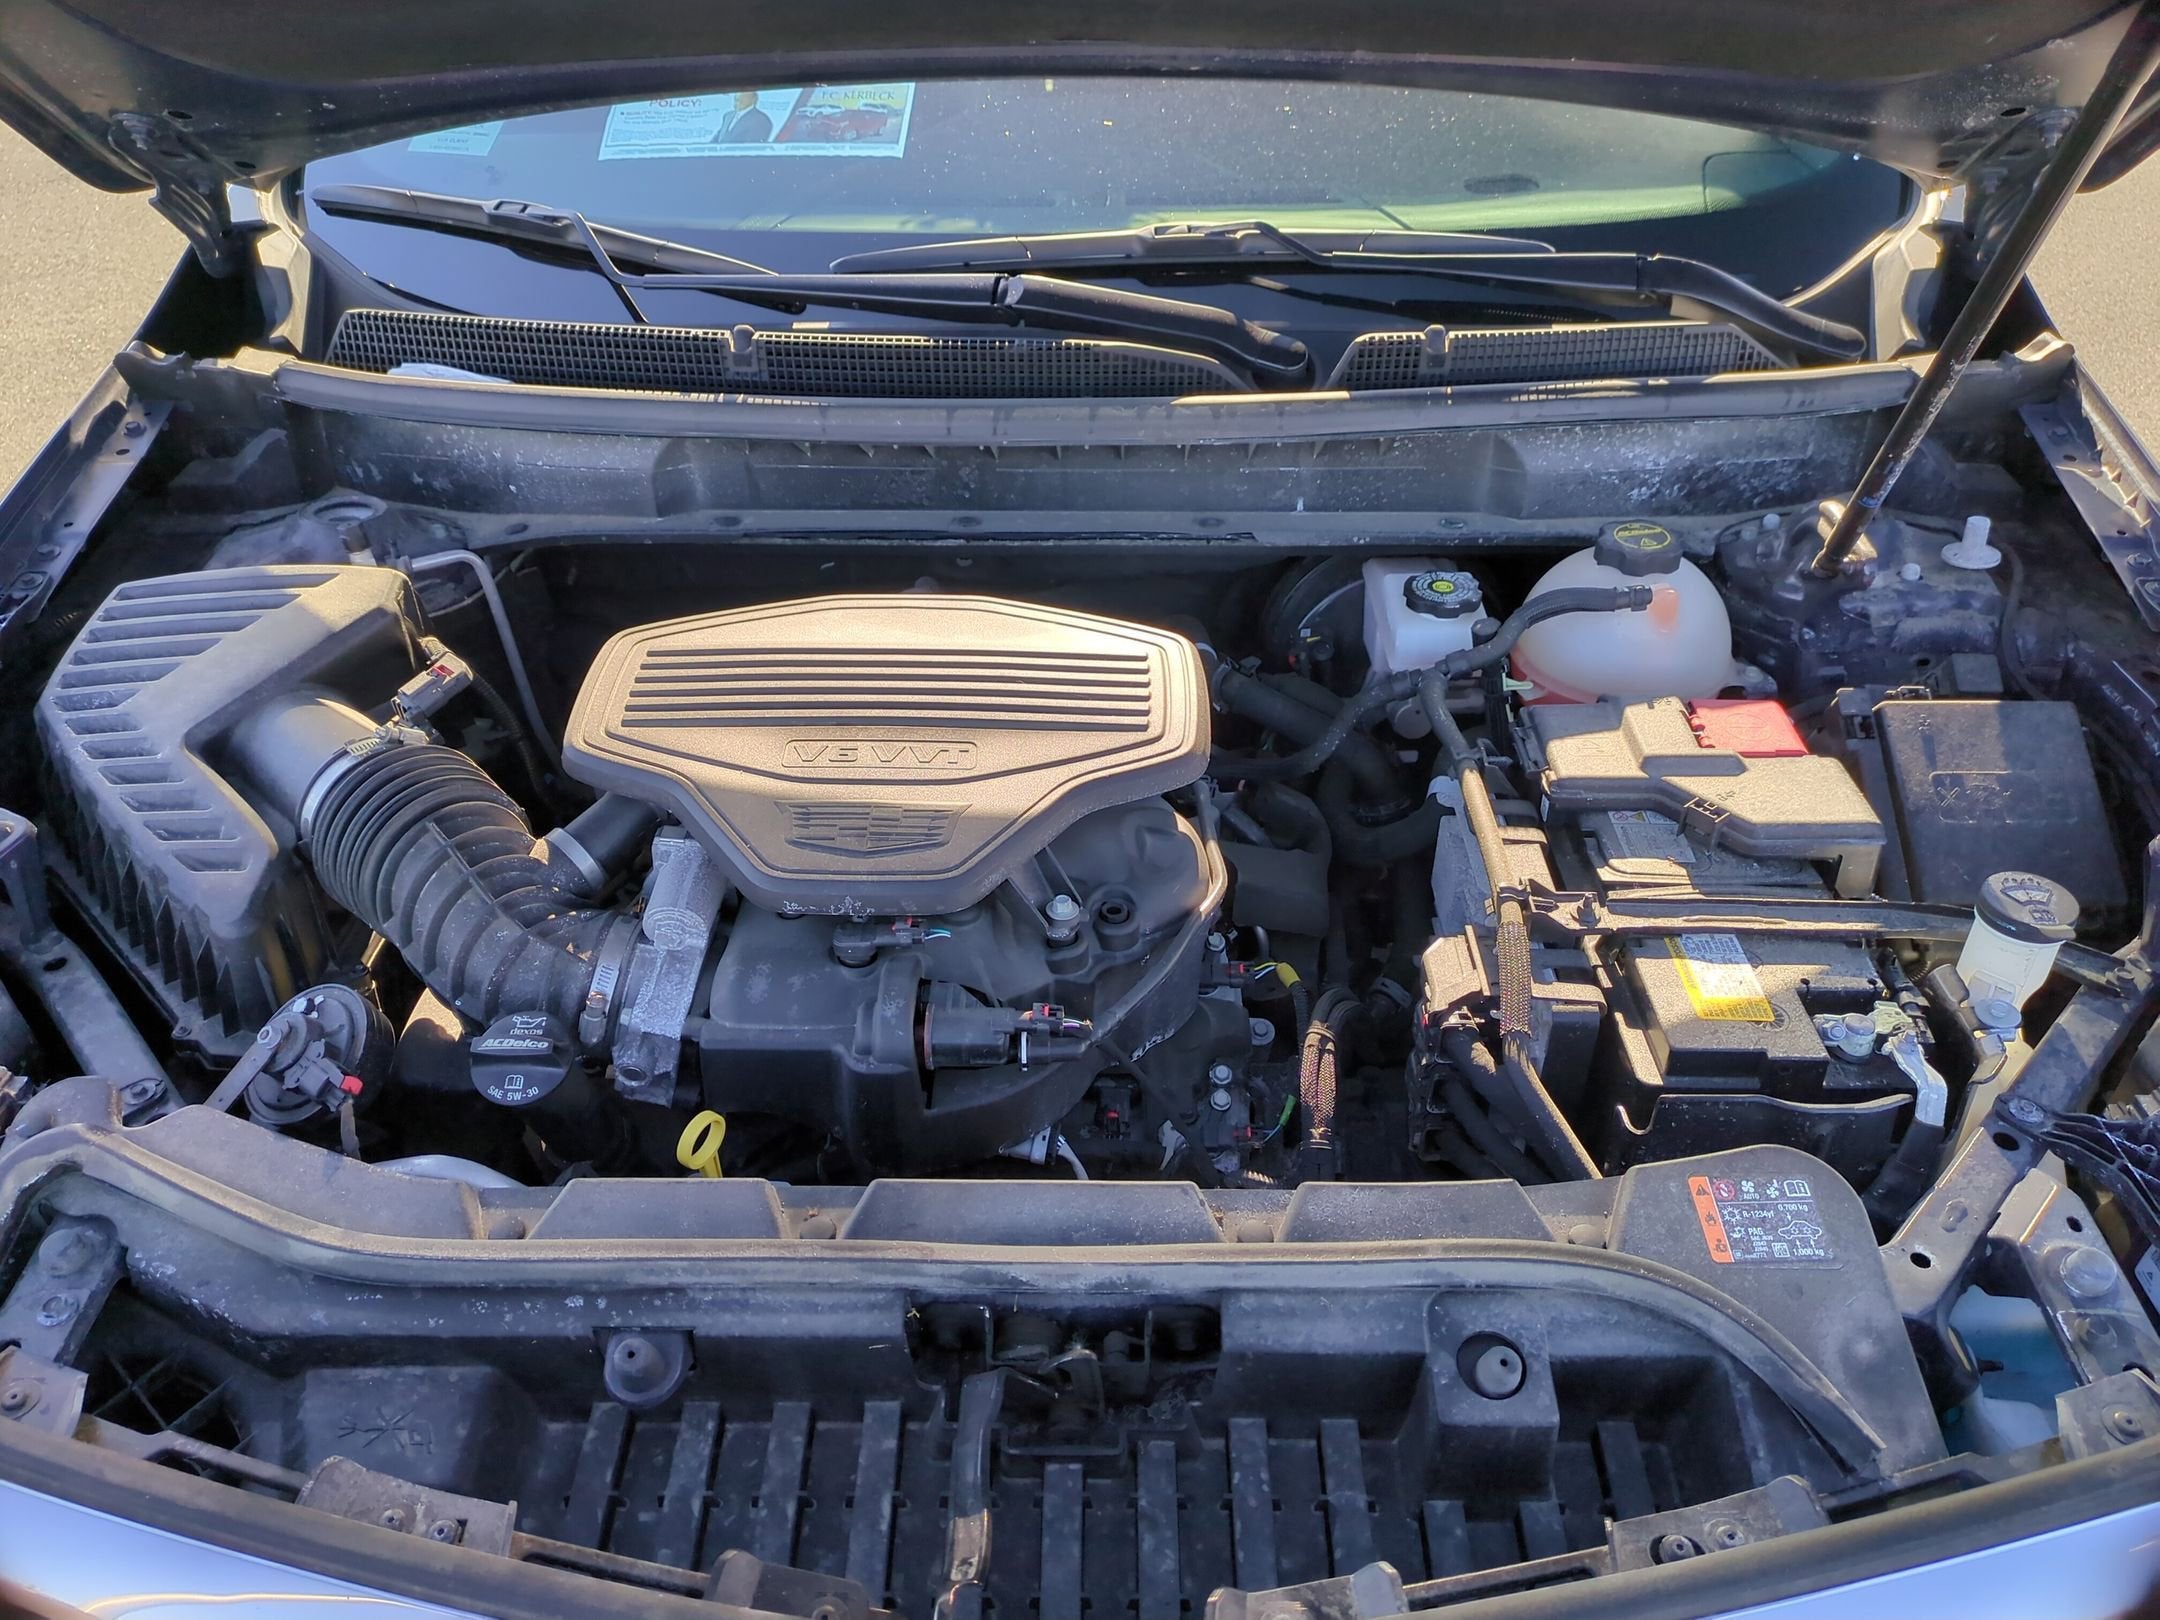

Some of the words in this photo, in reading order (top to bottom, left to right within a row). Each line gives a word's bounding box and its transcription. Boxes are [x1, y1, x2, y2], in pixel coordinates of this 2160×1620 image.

[793, 744, 858, 763] V6
[870, 745, 970, 765] VVT
[510, 1028, 543, 1036] dexos
[481, 1038, 549, 1048] ACDelco
[487, 1085, 504, 1099] SAE
[506, 1086, 539, 1101] 5W-30
